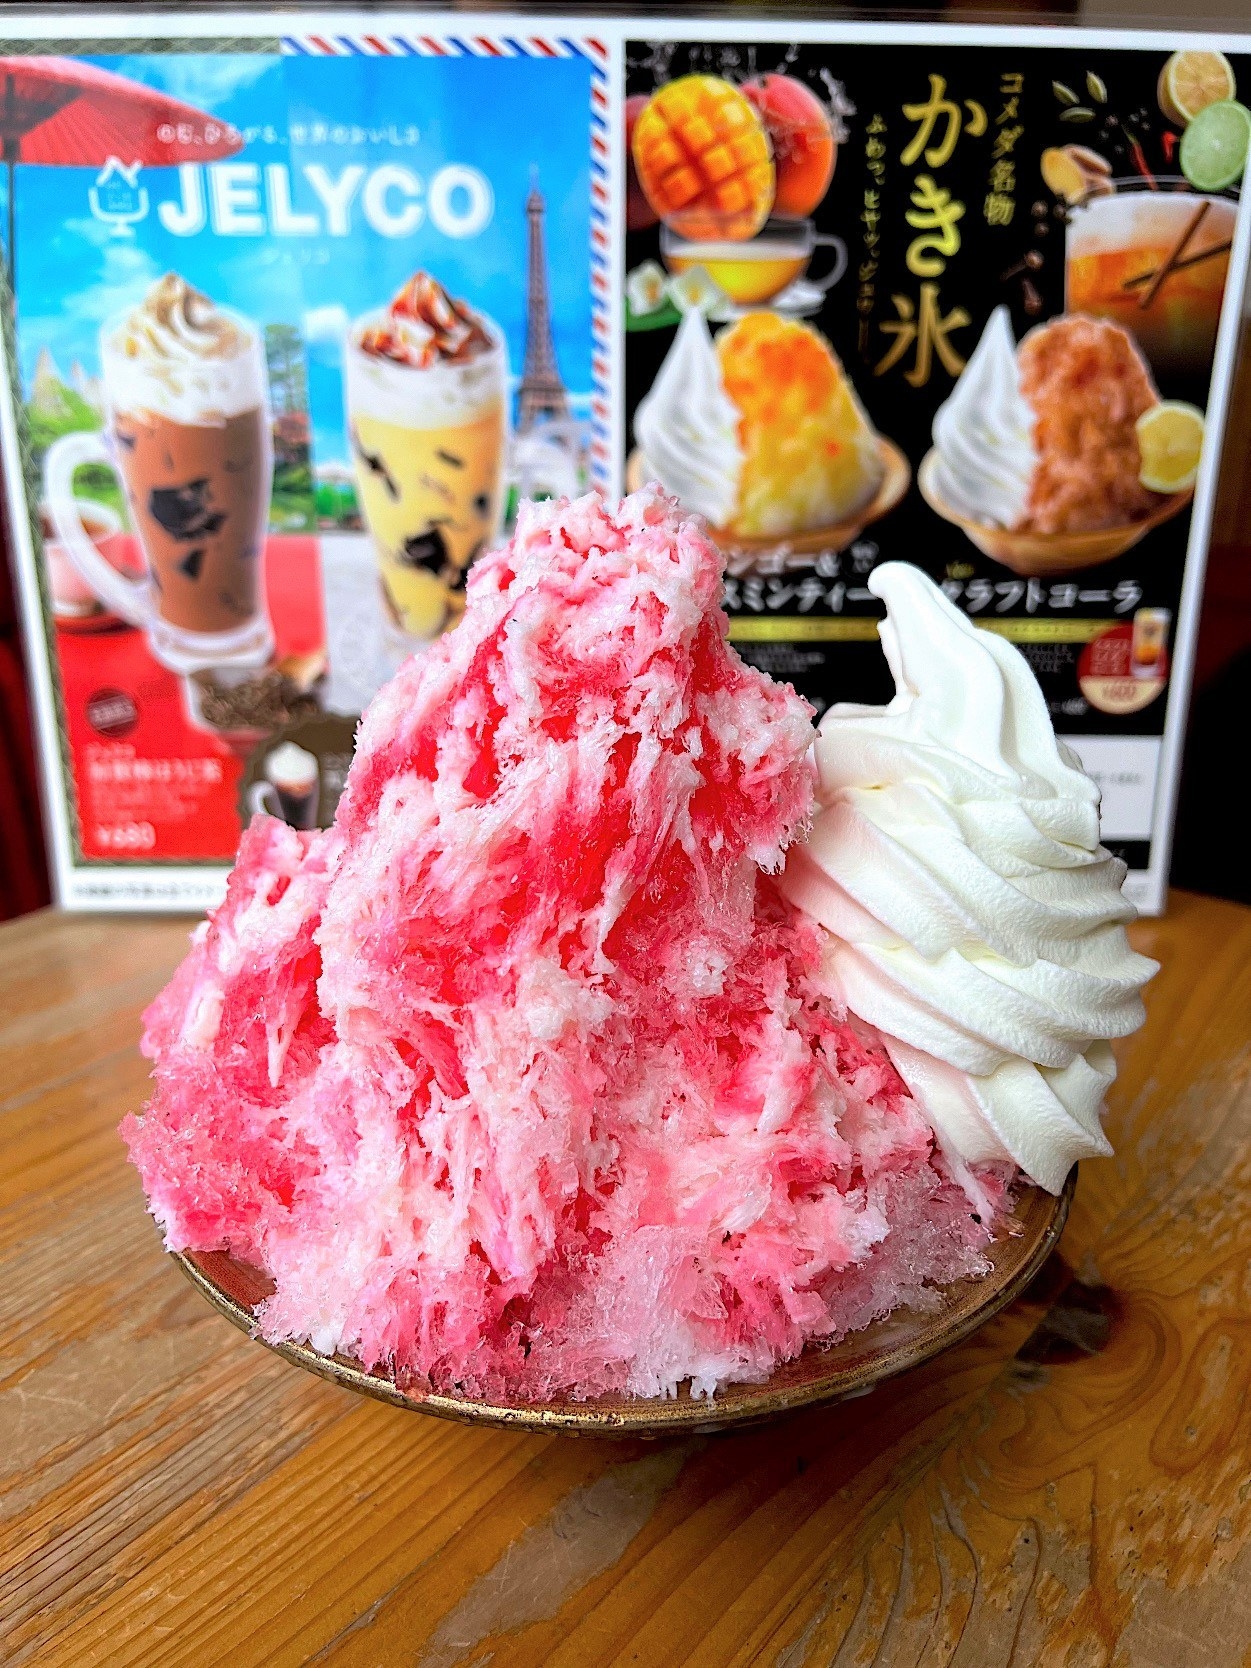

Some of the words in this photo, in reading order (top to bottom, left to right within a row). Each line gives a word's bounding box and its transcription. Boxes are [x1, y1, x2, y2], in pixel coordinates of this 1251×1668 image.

[157, 161, 494, 239] JELYCO
[984, 71, 1024, 226] コメダ名物
[871, 72, 989, 388] かき氷
